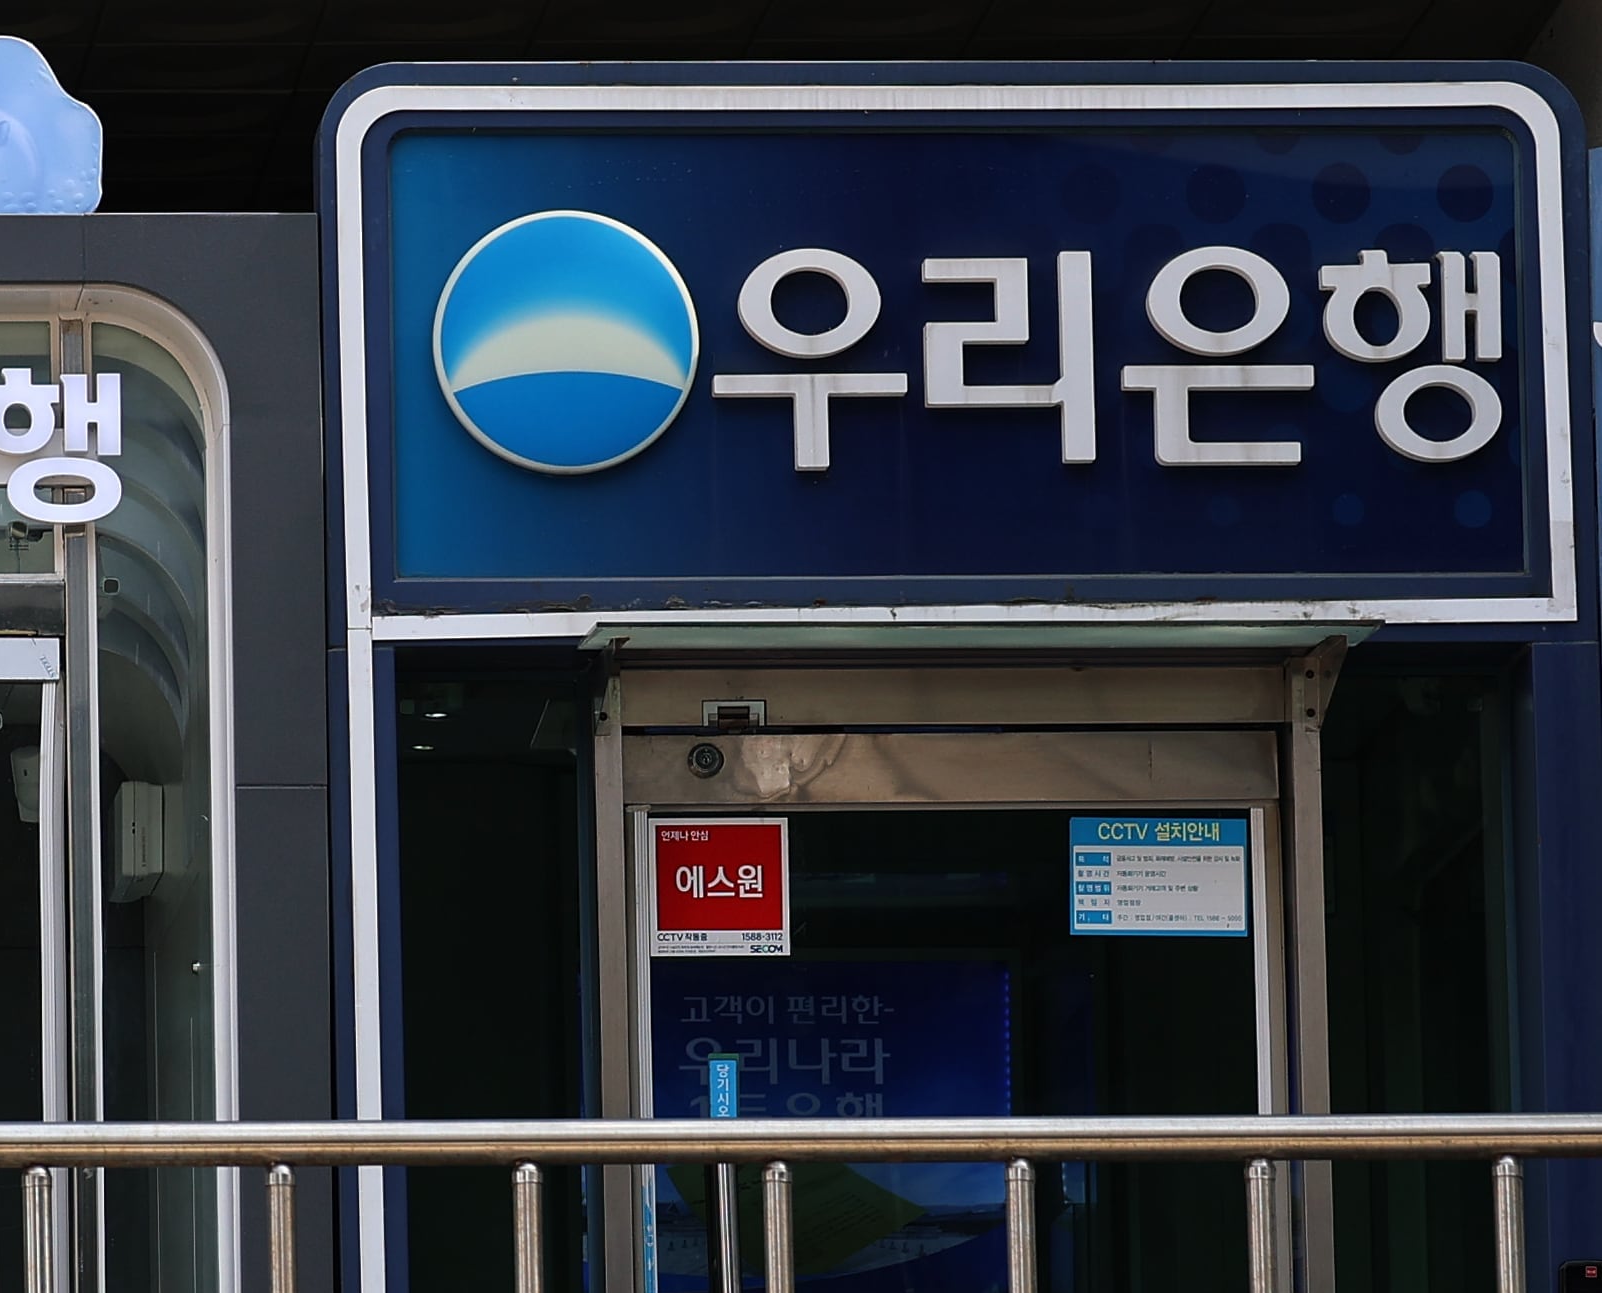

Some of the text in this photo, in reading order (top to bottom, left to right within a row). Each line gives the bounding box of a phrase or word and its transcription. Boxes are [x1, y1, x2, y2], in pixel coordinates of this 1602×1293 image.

[712, 245, 1503, 472] 우리은행
[661, 831, 708, 841] 언제나 안심
[1098, 823, 1219, 841] CCTV 설치안내
[676, 865, 763, 898] 에스원
[657, 933, 683, 941] CCTV
[680, 996, 774, 1025] 고객이
[717, 1064, 730, 1117] 당기시오
